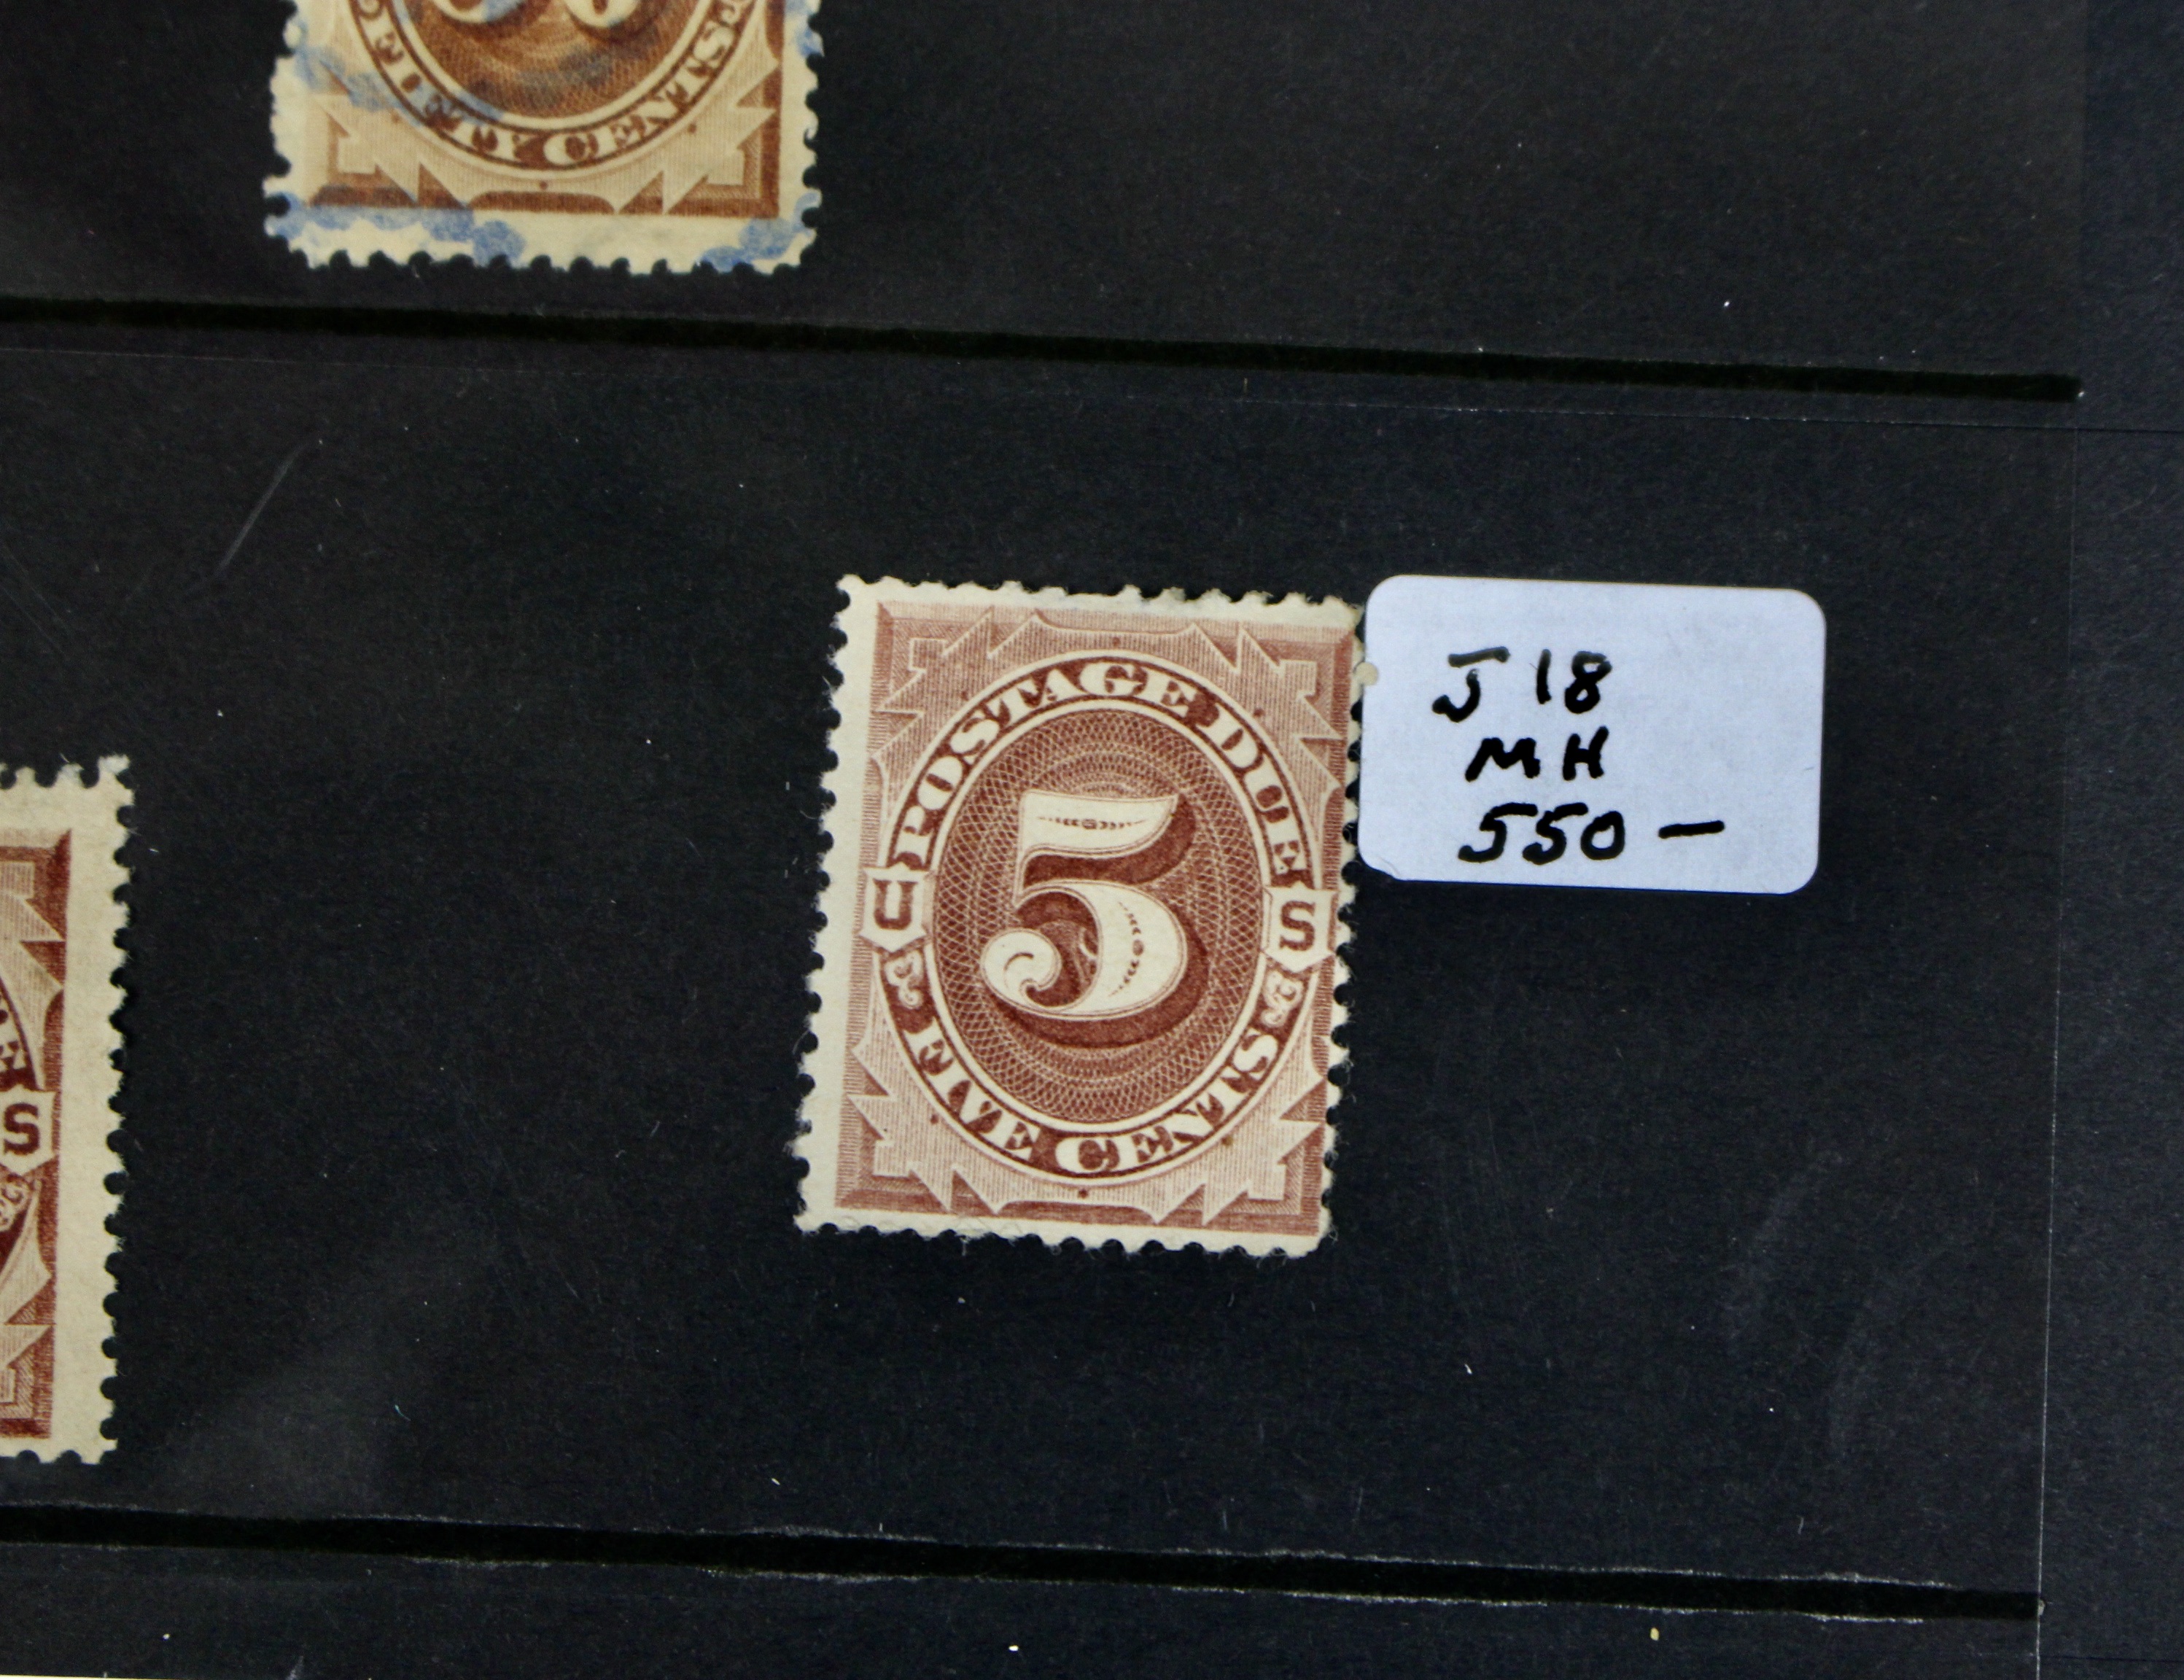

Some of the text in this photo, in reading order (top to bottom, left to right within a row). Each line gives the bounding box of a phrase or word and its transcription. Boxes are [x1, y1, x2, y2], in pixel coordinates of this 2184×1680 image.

[543, 20, 735, 166] CENTS
[1535, 648, 1613, 715] 18
[898, 660, 1309, 874] POSTAGE DUE
[874, 879, 913, 931] U
[979, 790, 1186, 1022] 5
[1278, 900, 1315, 950] S
[4, 1102, 40, 1156] S
[902, 1016, 1281, 1175] FIVE CENTS
